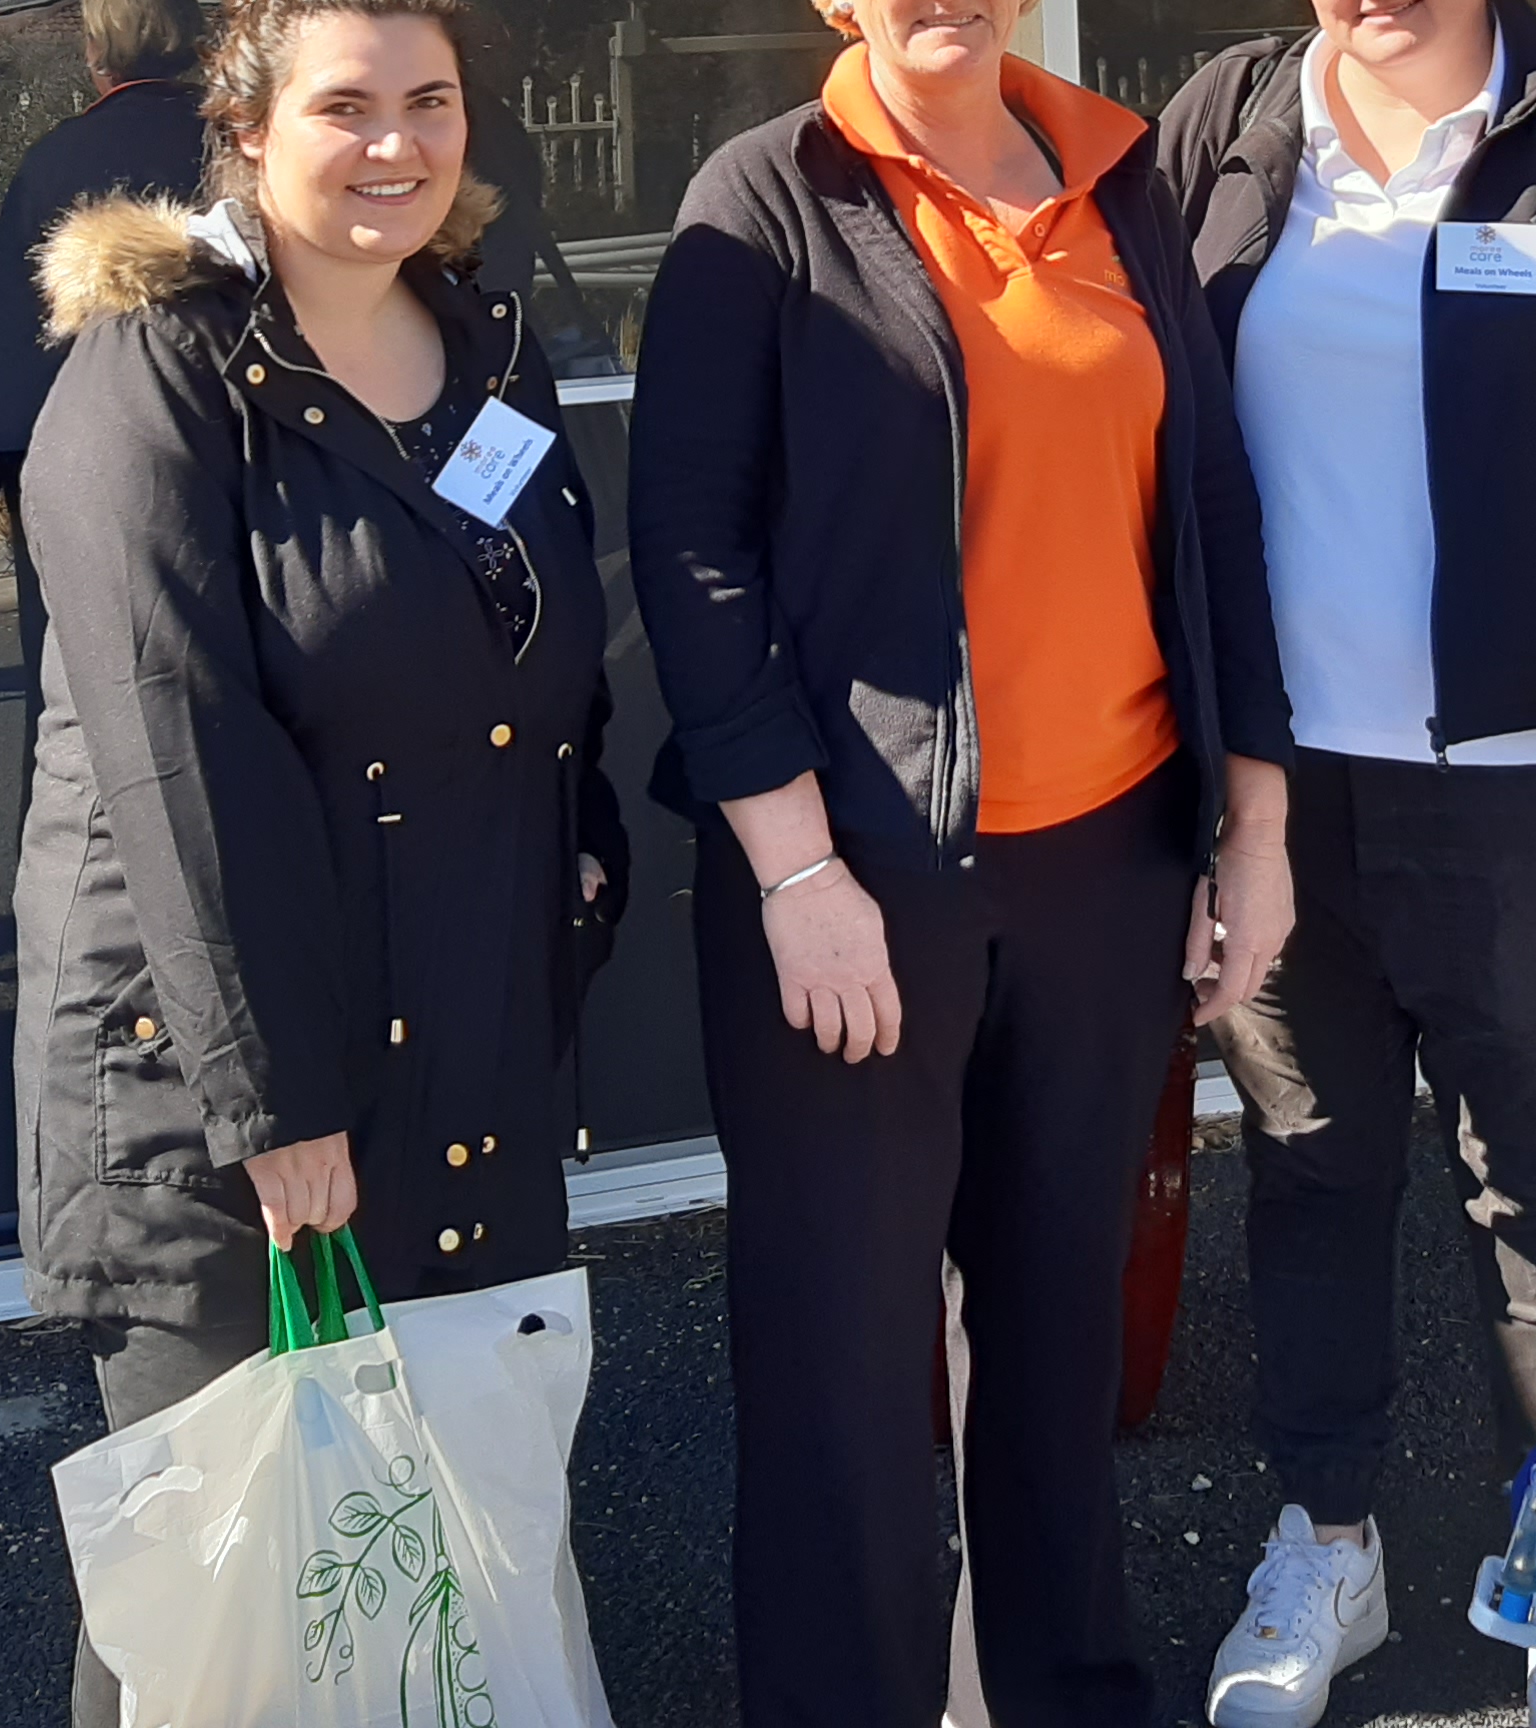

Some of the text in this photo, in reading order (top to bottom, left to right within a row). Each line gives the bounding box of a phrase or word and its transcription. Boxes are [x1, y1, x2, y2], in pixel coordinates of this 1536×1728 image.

[1469, 252, 1502, 262] care
[1454, 267, 1482, 275] Meals
[1498, 269, 1532, 278] Wheels
[481, 450, 506, 479] care
